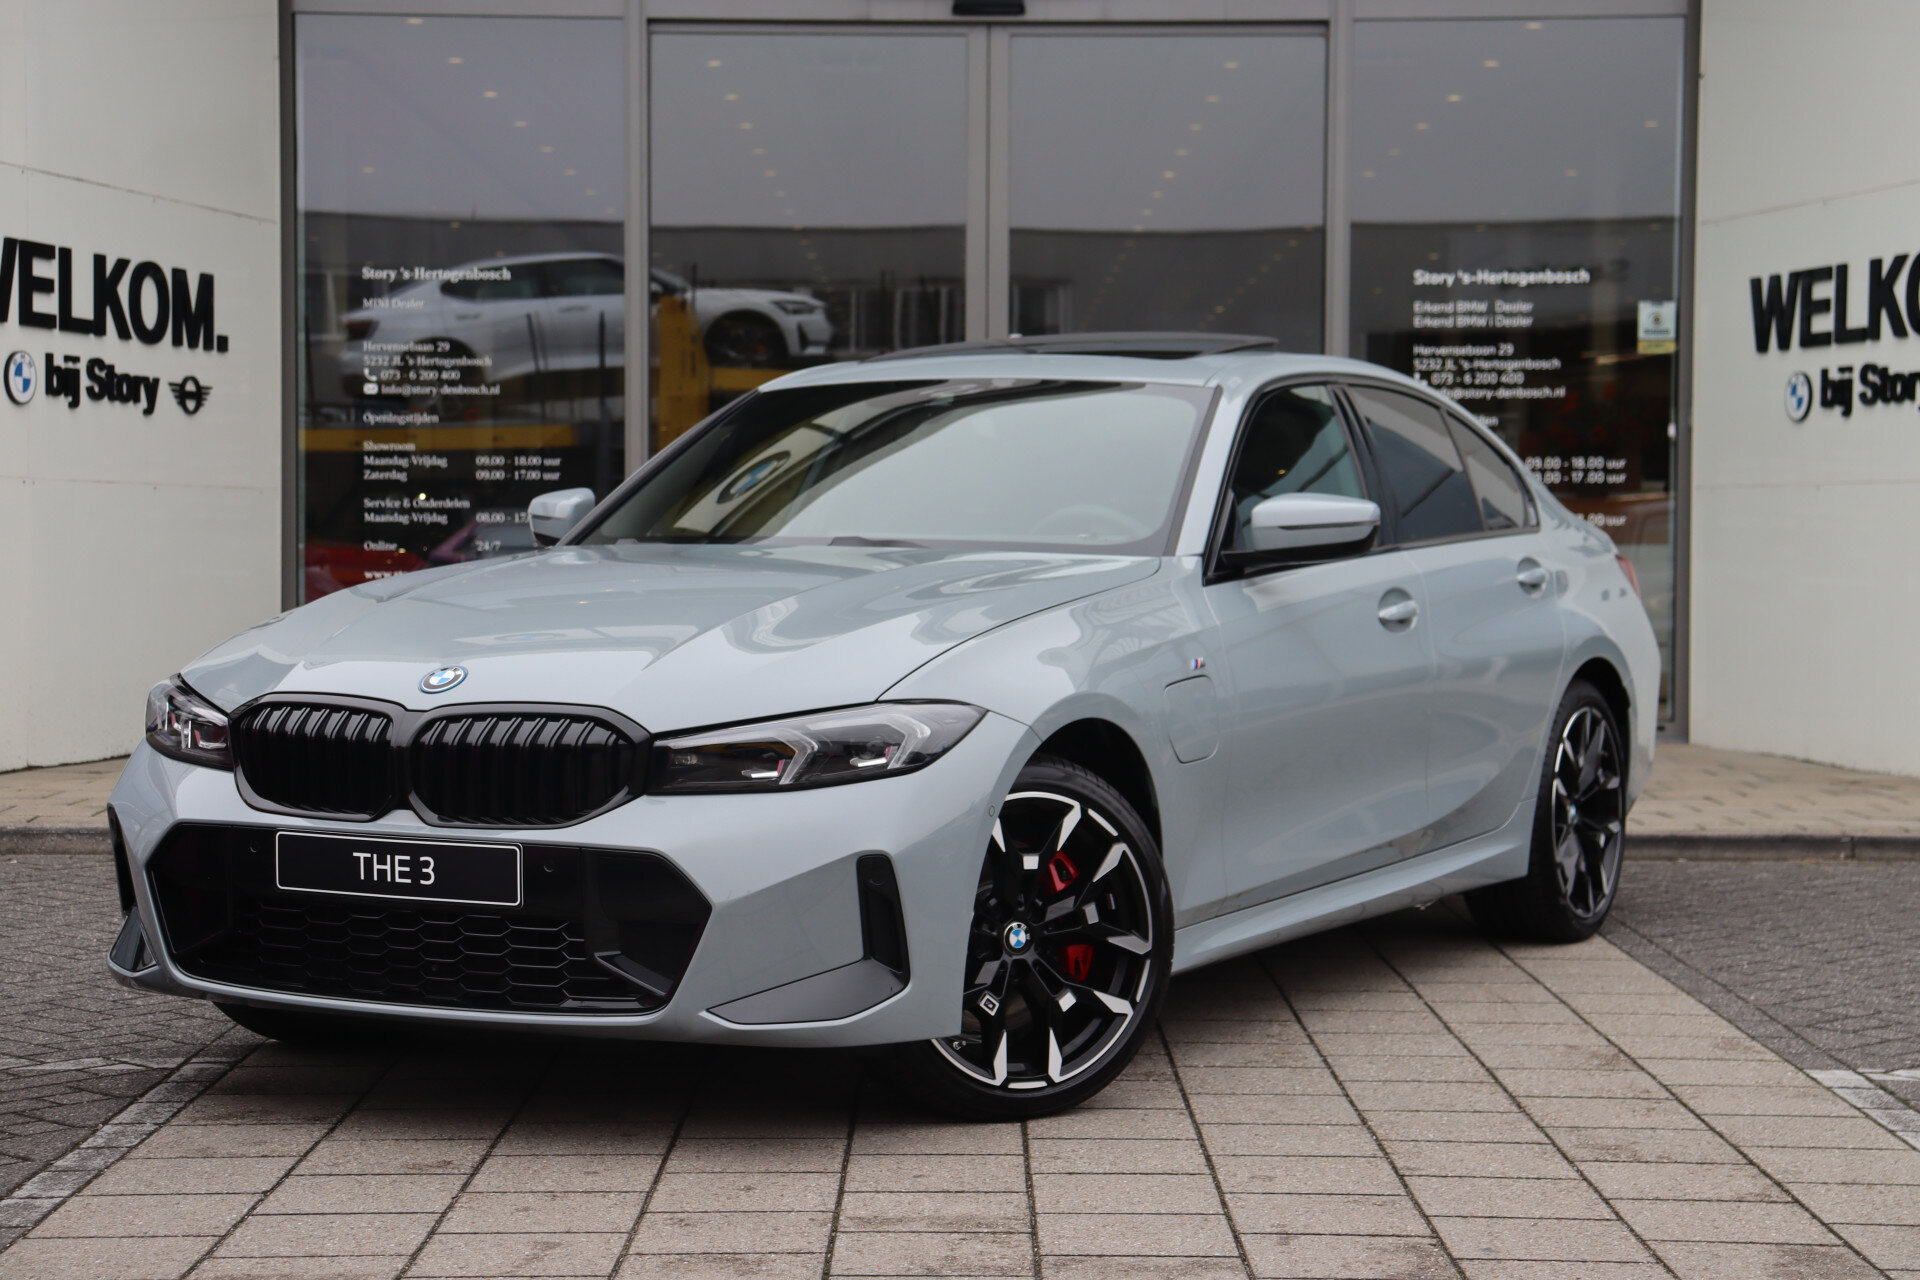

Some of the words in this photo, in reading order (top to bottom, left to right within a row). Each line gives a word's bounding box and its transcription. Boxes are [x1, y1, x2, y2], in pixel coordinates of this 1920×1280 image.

[361, 267, 396, 281] Story
[1413, 268, 1455, 288] Story
[1457, 267, 1591, 287] 's-Hertogenbosch
[1413, 300, 1455, 314] Erkend
[1456, 300, 1488, 314] BMW
[1494, 300, 1534, 314] Dealer
[1413, 314, 1455, 328] Erkend
[1456, 314, 1488, 328] BMW
[1494, 314, 1534, 328] Dealer
[436, 341, 451, 353] 29
[1498, 343, 1514, 356] 29
[380, 369, 401, 381] 073
[408, 369, 418, 381] 6
[418, 369, 439, 381] 200
[440, 369, 461, 381] 400
[1430, 371, 1454, 385] 073
[1463, 371, 1473, 385] 6
[1474, 371, 1498, 385] 200
[1499, 371, 1525, 385] 400
[45, 352, 81, 409] bij
[85, 357, 160, 417] Story
[1820, 366, 1853, 418] bij
[1859, 363, 1920, 412] Stor
[1438, 386, 1566, 401] fo@story-denbosch.nl
[363, 440, 416, 452] Showroom
[475, 455, 505, 467] 09.00
[514, 455, 542, 467] 18.00
[543, 458, 561, 467] uur
[1606, 458, 1627, 470] uur
[363, 470, 408, 482] Zaterdag
[475, 470, 505, 481] 09.00
[514, 470, 542, 481] 17.00
[543, 472, 561, 481] uur
[1571, 470, 1605, 484] 17.00
[1606, 473, 1627, 484] uur
[363, 498, 402, 509] Service
[403, 498, 412, 509] &
[413, 498, 470, 509] Onderdelen
[1606, 515, 1627, 526] uur
[363, 541, 398, 552] Online
[475, 540, 501, 552] 24/7
[352, 852, 412, 884] THE
[419, 856, 436, 885] 3
